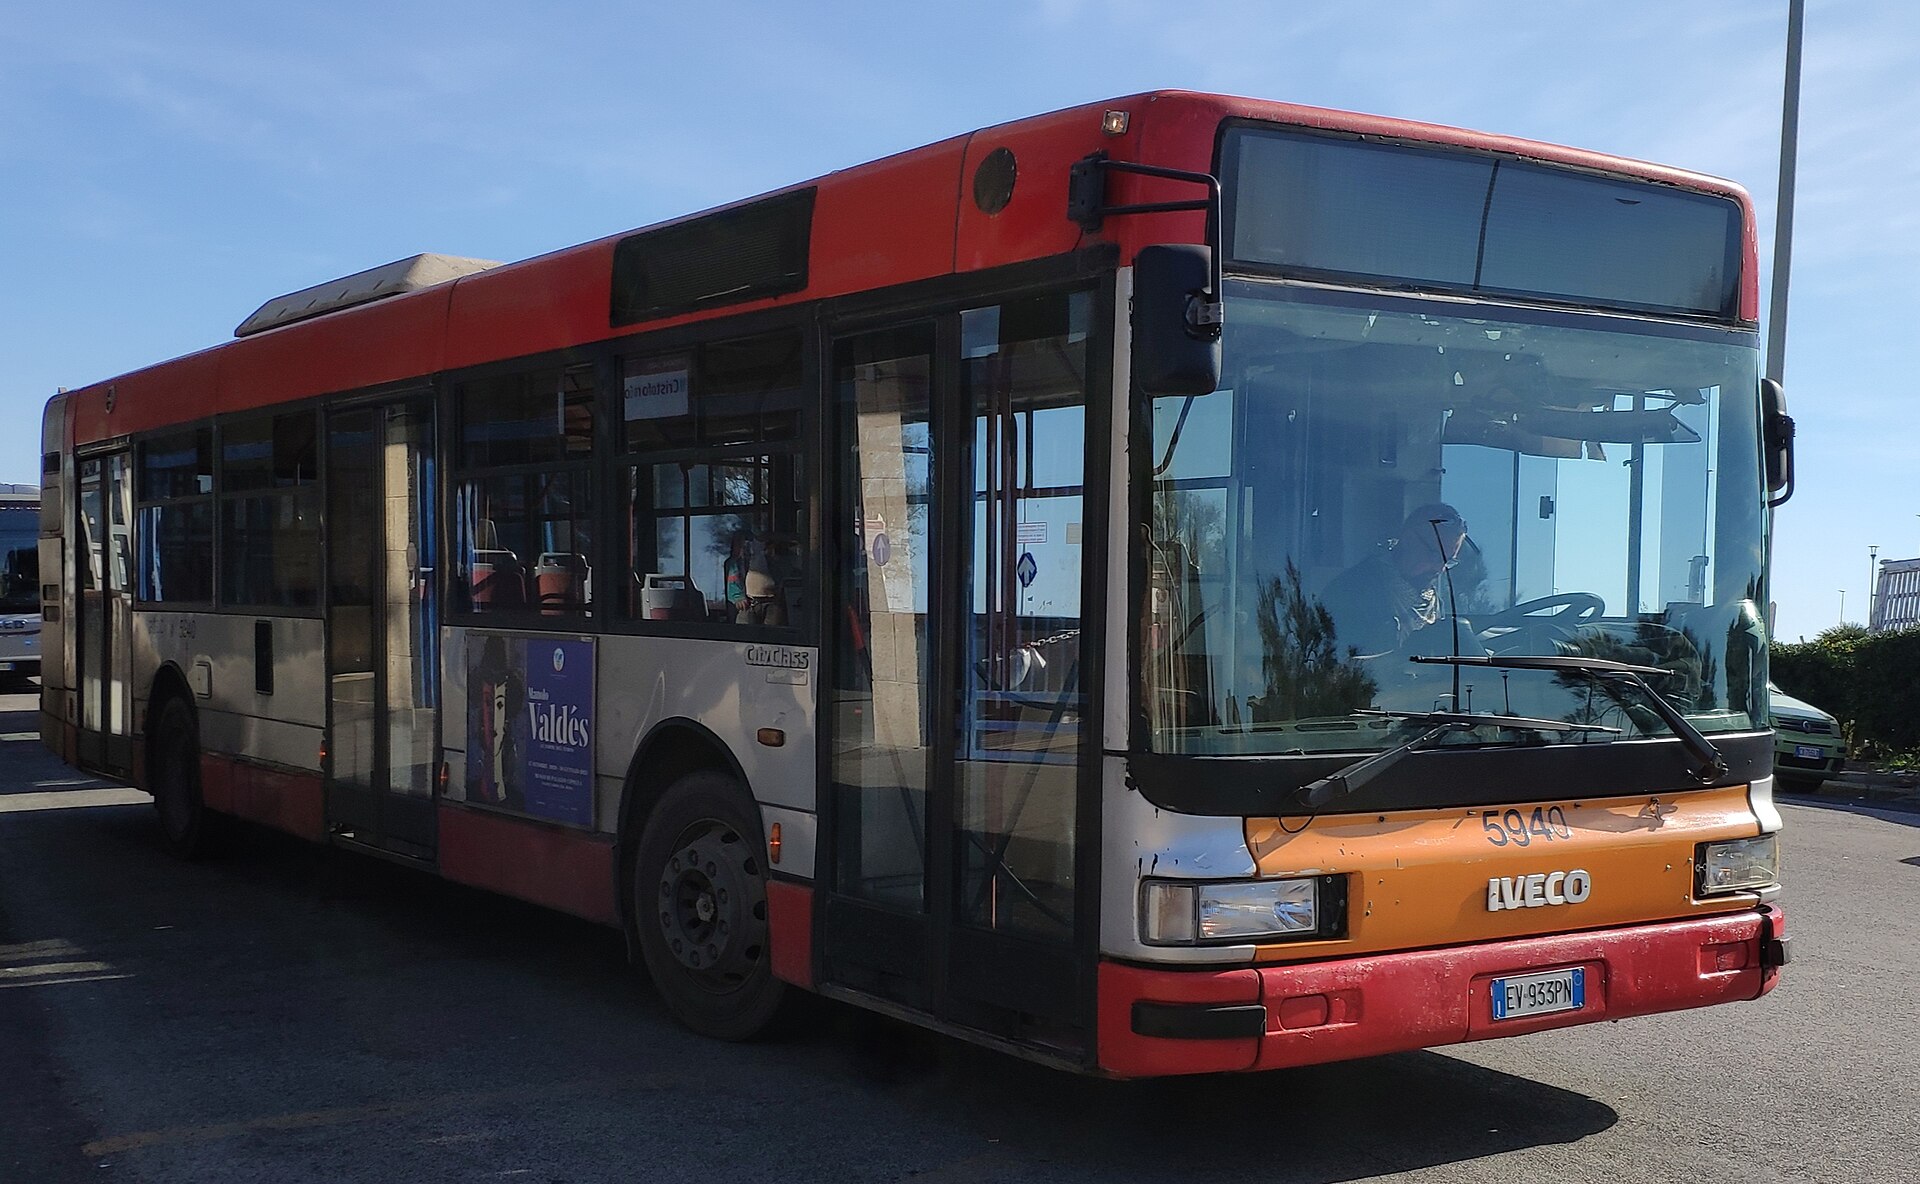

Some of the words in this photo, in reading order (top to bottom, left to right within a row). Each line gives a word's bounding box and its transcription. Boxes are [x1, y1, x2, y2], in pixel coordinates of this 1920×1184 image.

[528, 702, 589, 748] Valdés
[1482, 805, 1570, 847] 5940
[1487, 868, 1592, 912] IVECO
